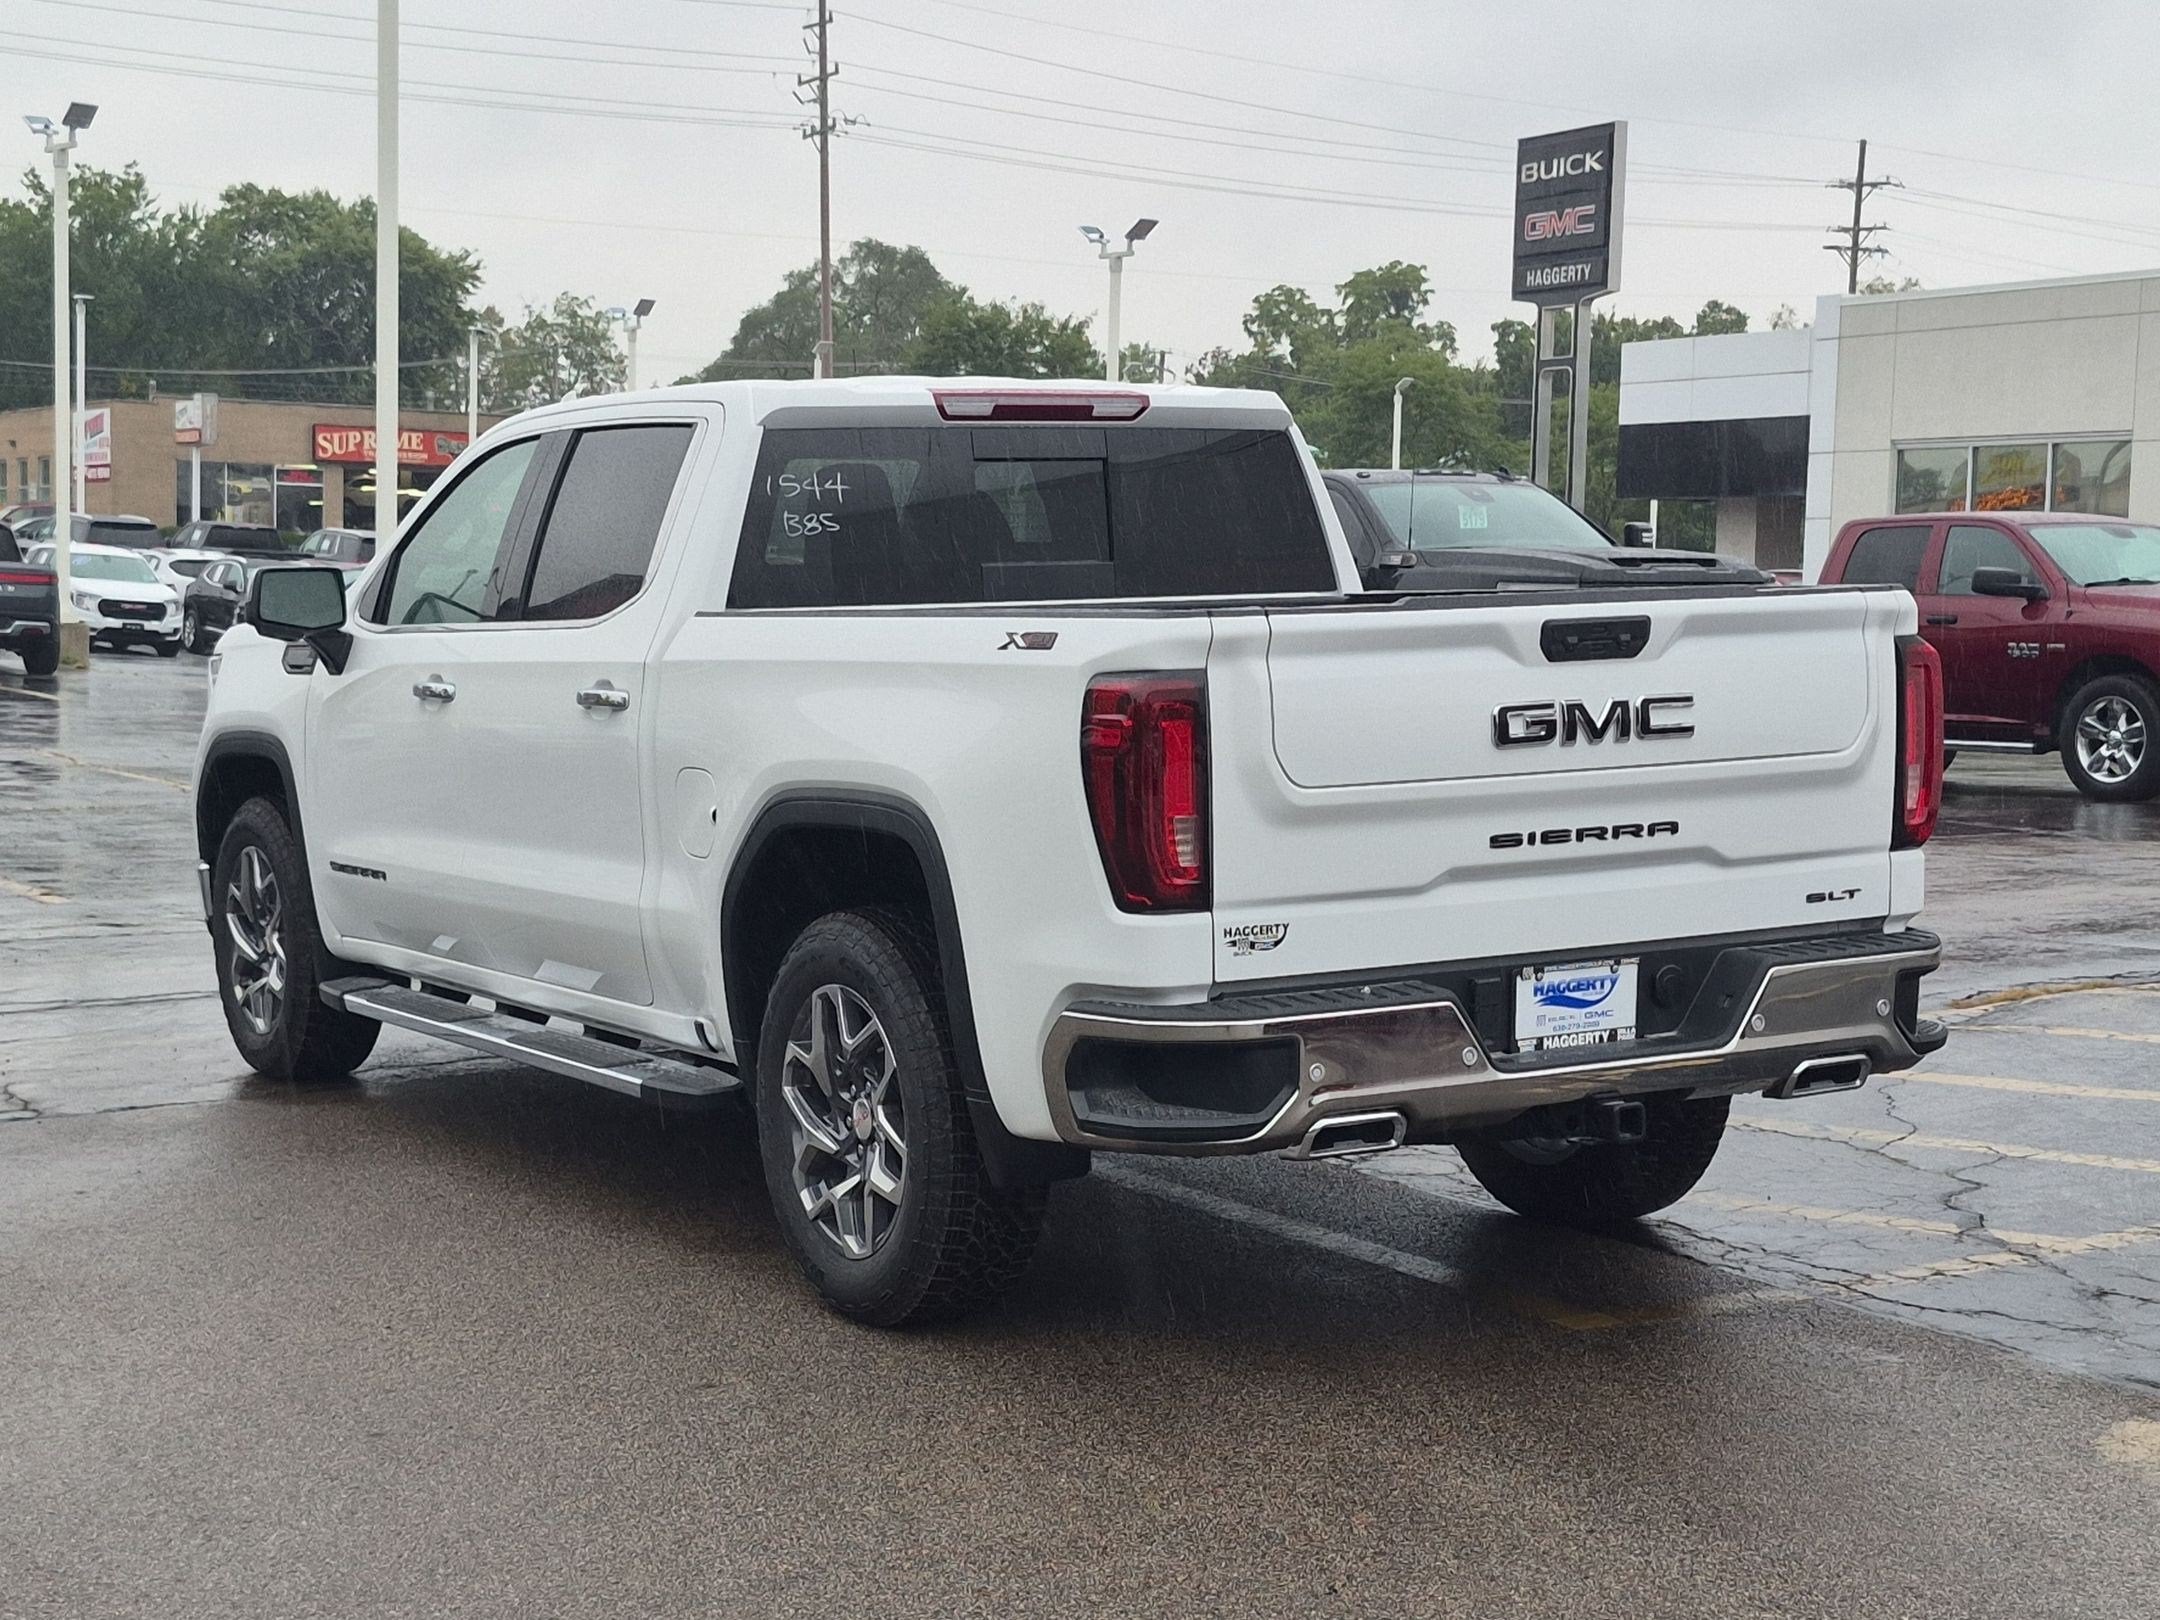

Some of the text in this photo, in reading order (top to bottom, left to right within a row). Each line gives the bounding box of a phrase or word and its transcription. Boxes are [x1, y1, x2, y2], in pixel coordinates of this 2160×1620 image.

[1520, 150, 1605, 183] BUICK
[1524, 204, 1596, 241] GMC
[1526, 263, 1592, 287] HAGGERTY
[317, 430, 424, 458] SUPRME
[766, 472, 851, 504] 1544
[783, 510, 841, 537] B85
[1491, 692, 1696, 750] GMC
[1489, 820, 1680, 849] SIERRA
[1805, 887, 1862, 904] SLT
[1223, 922, 1290, 939] HAGGERTY
[1533, 974, 1620, 997] HAGGERTY
[1584, 1009, 1615, 1020] GMC
[1542, 1029, 1611, 1050] HAGGERTY
